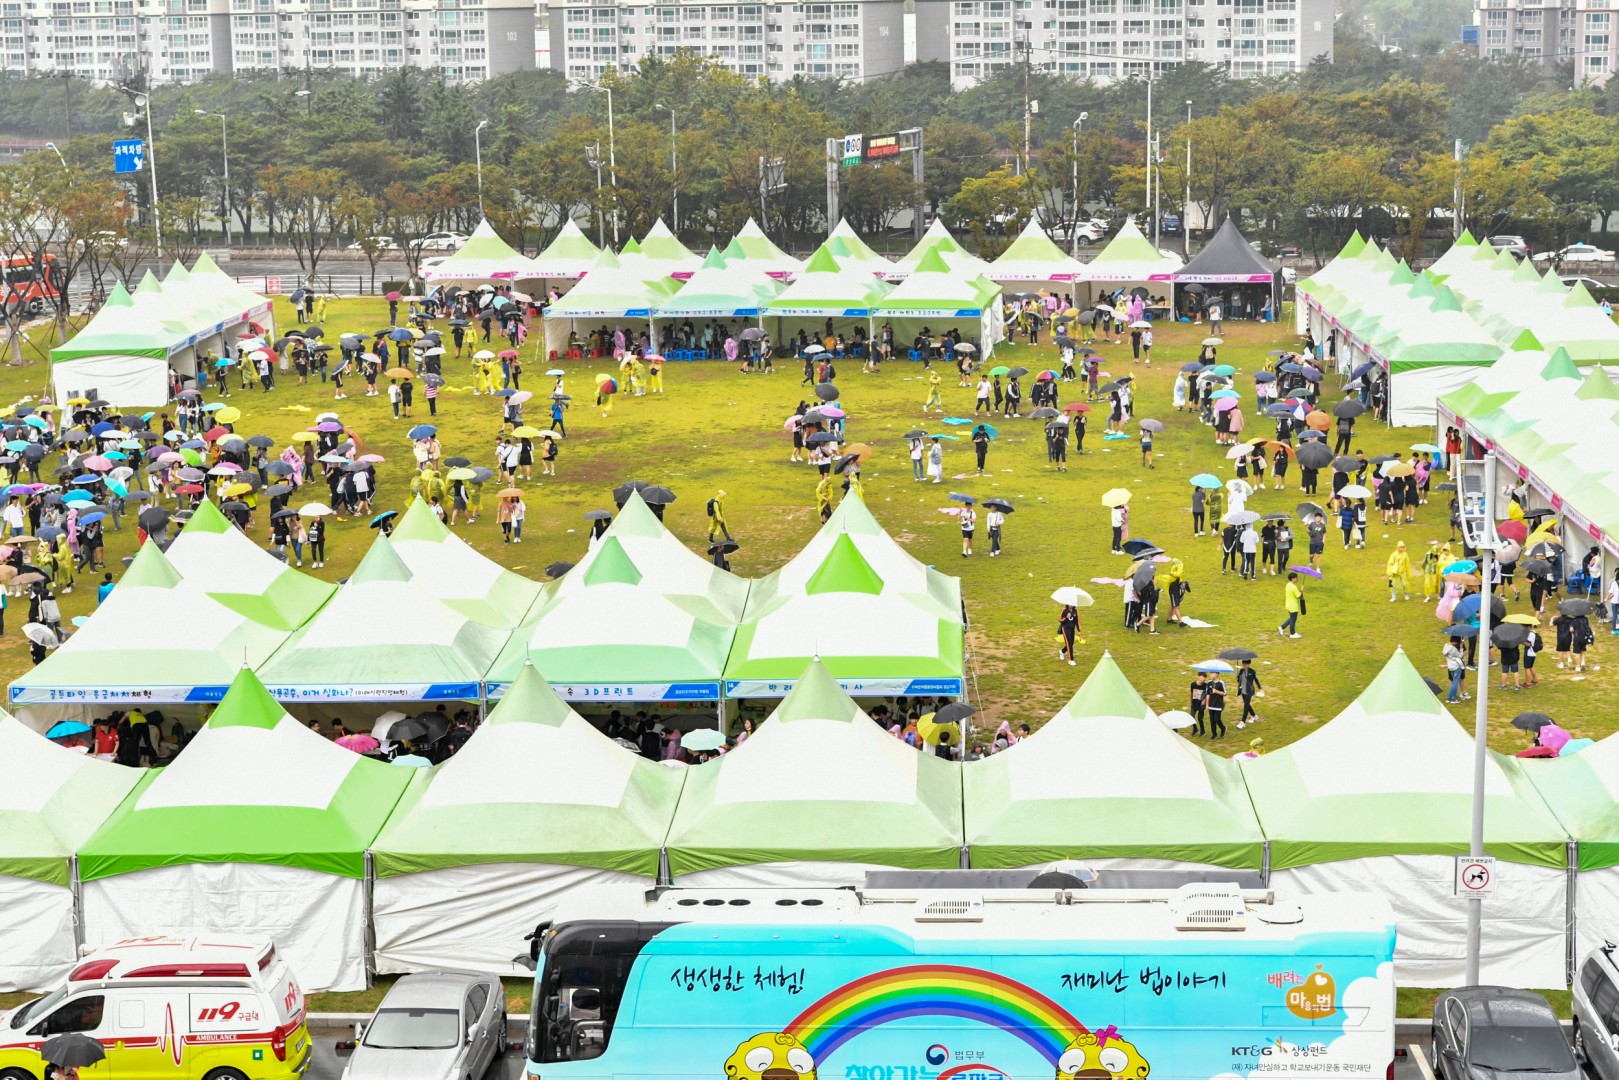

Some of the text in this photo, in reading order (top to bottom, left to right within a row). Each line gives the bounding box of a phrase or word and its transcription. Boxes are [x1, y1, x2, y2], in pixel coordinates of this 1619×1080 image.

[507, 31, 518, 41] 102
[302, 689, 320, 697] 이거
[670, 965, 805, 995] 생생한 체험!
[1061, 966, 1227, 996] 재미난 법이야기
[1267, 970, 1305, 989] 배려는
[196, 1001, 259, 1022] 119 구급대
[954, 1050, 985, 1061] 법무부
[1231, 1045, 1328, 1057] KT&G 상상펀드
[1231, 1063, 1371, 1073] (재) 자녀안심하고 학교보내기운동 국민재단
